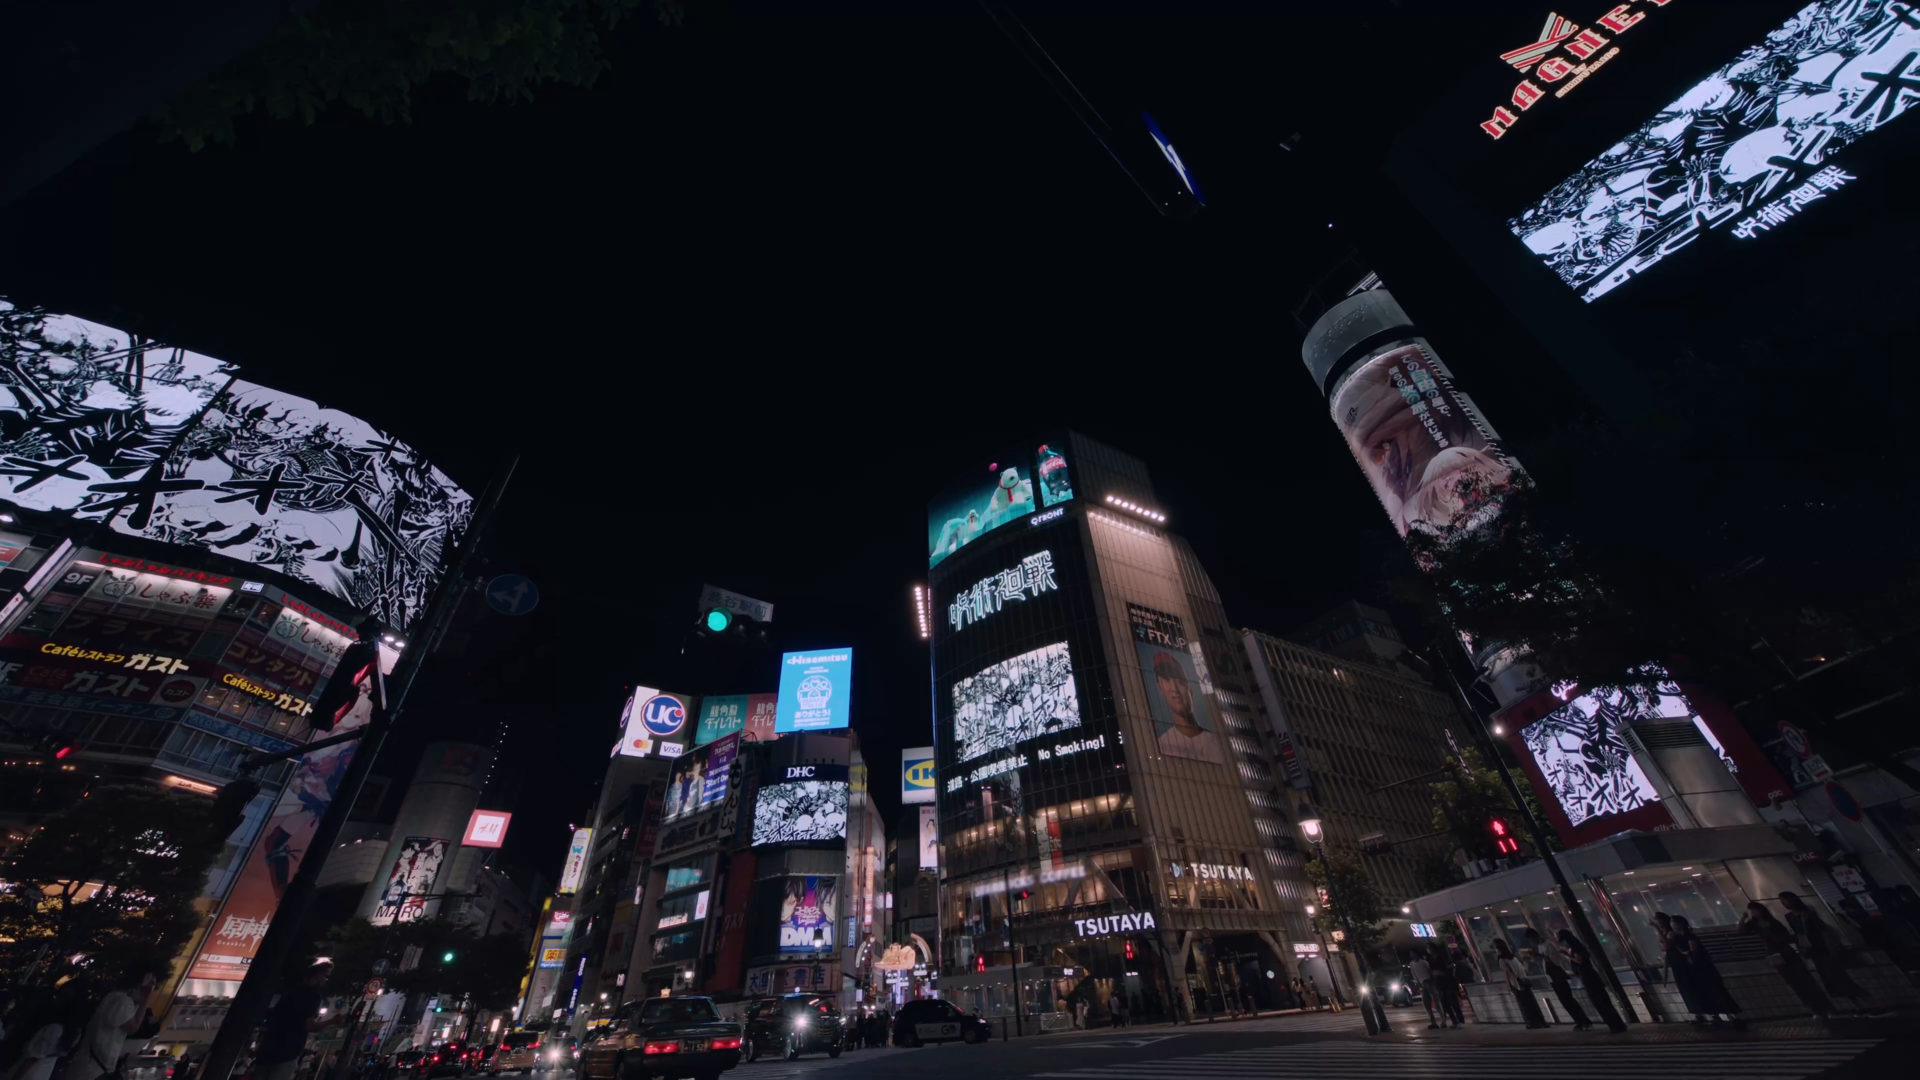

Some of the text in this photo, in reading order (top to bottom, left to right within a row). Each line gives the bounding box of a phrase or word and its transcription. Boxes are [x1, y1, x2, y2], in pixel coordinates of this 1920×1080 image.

[64, 572, 95, 585] 9F
[123, 652, 190, 675] ガスト
[63, 670, 150, 697] ガスト
[274, 692, 313, 717] ガスト
[646, 703, 681, 727] UC
[1038, 748, 1051, 760] No
[1055, 734, 1105, 756] Smoking!
[786, 766, 816, 778] DHC
[1191, 862, 1255, 881] TSUTAYA
[1074, 911, 1156, 937] TSUTAYA
